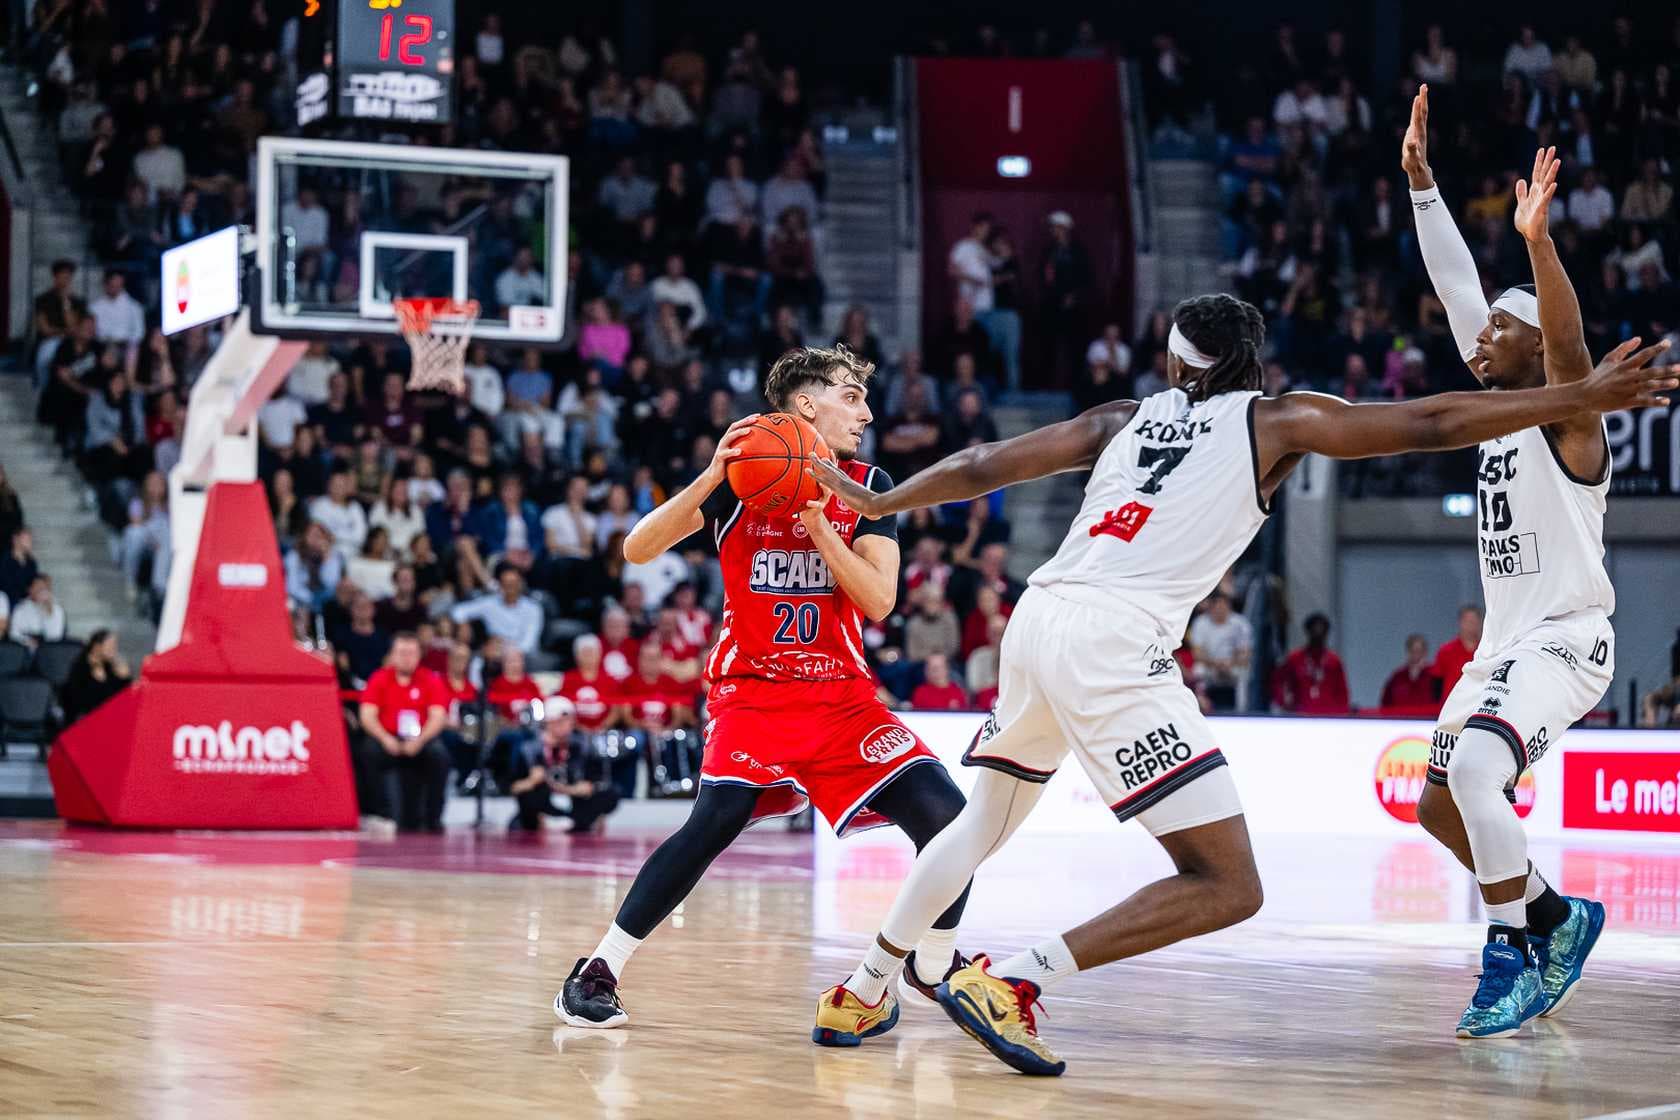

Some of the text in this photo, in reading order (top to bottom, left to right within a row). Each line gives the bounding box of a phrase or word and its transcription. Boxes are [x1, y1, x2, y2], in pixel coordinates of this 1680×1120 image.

[379, 13, 432, 65] 12
[1137, 445, 1193, 495] 7
[1480, 489, 1513, 532] 10
[773, 602, 820, 644] 20
[173, 719, 310, 761] minet
[872, 733, 911, 760] FRAIS
[1115, 723, 1180, 767] CAEN
[1120, 741, 1192, 790] REPRO
[1595, 768, 1629, 814] Le
